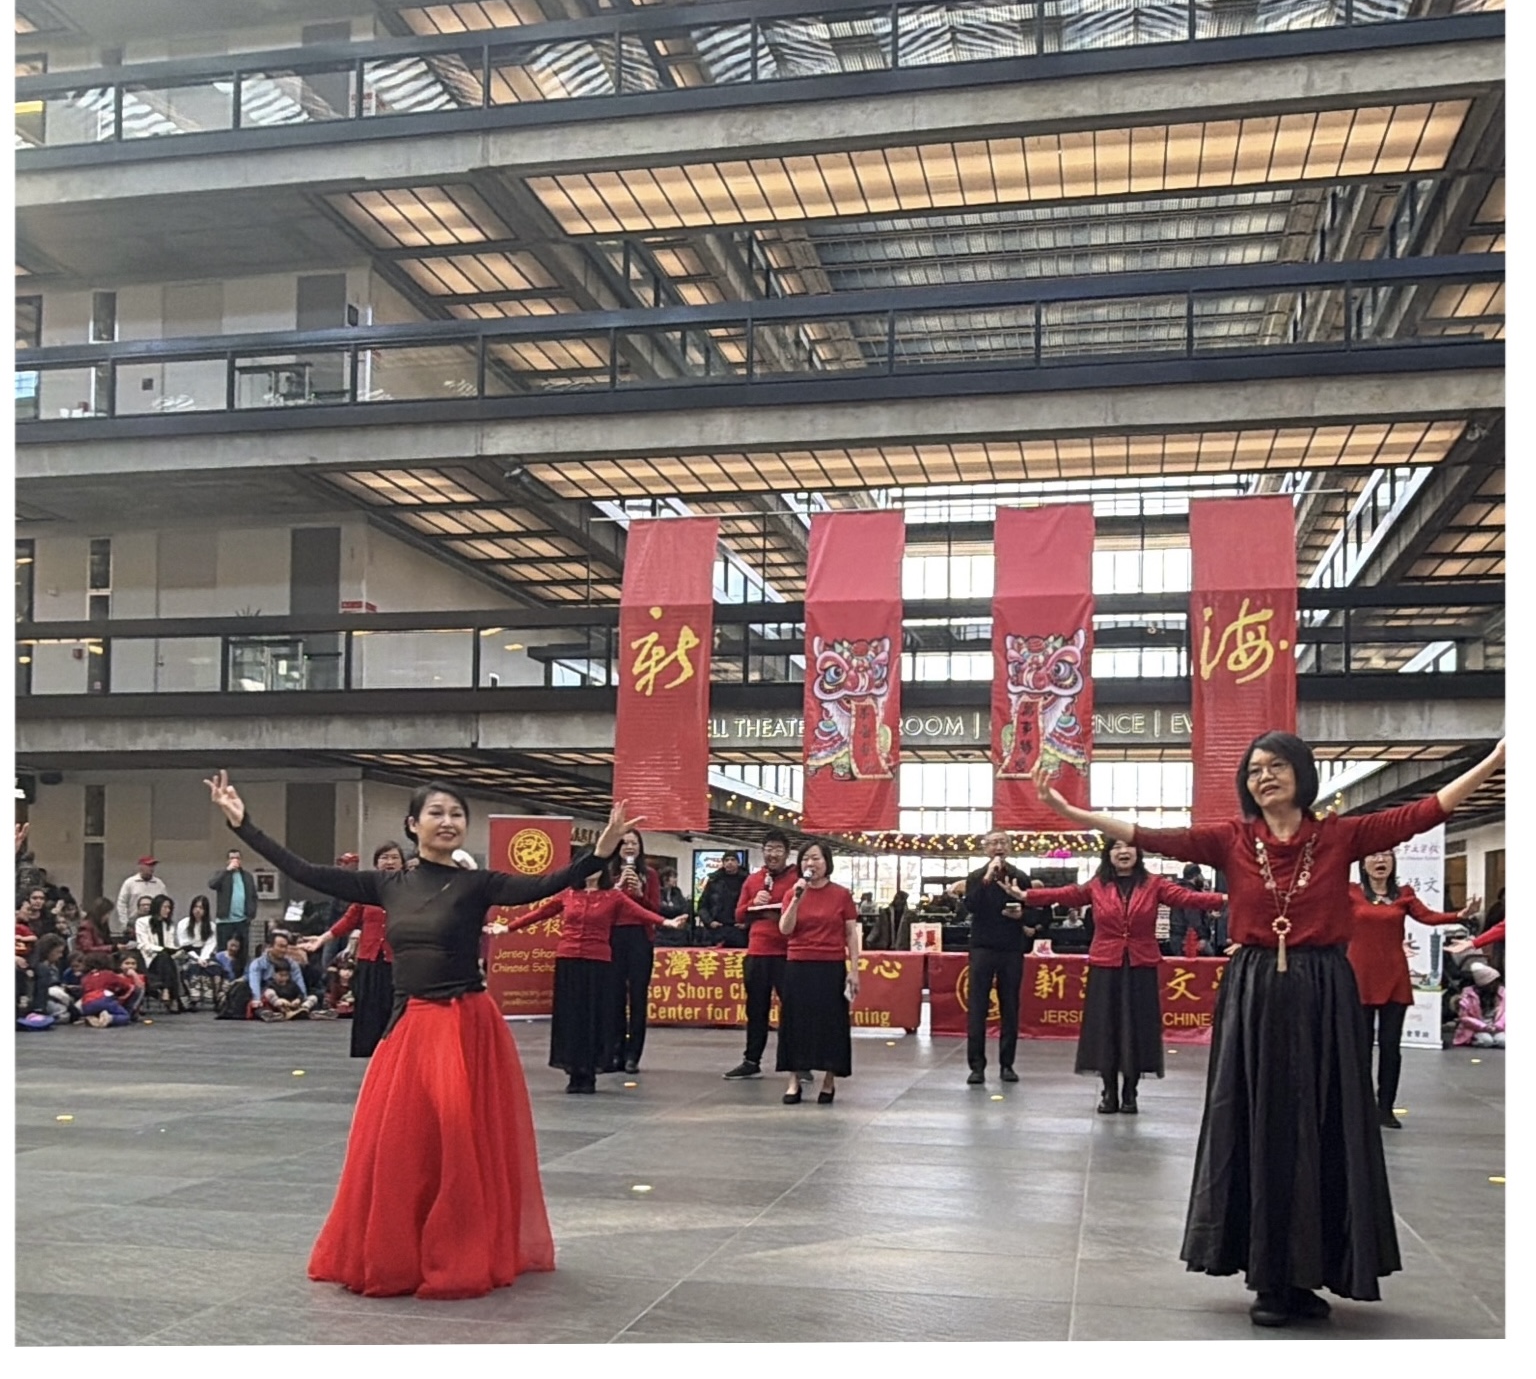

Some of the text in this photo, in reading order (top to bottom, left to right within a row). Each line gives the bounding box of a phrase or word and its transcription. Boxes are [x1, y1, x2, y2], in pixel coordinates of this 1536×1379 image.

[1199, 597, 1289, 684] 海
[494, 948, 529, 961] Jersey
[491, 964, 529, 974] Chinese
[651, 949, 748, 981] 灣華語
[676, 982, 724, 1000] Shore
[646, 1002, 701, 1020] Center
[707, 1003, 731, 1020] for
[849, 1007, 891, 1027] ning
[1162, 1012, 1213, 1027] CHINE
